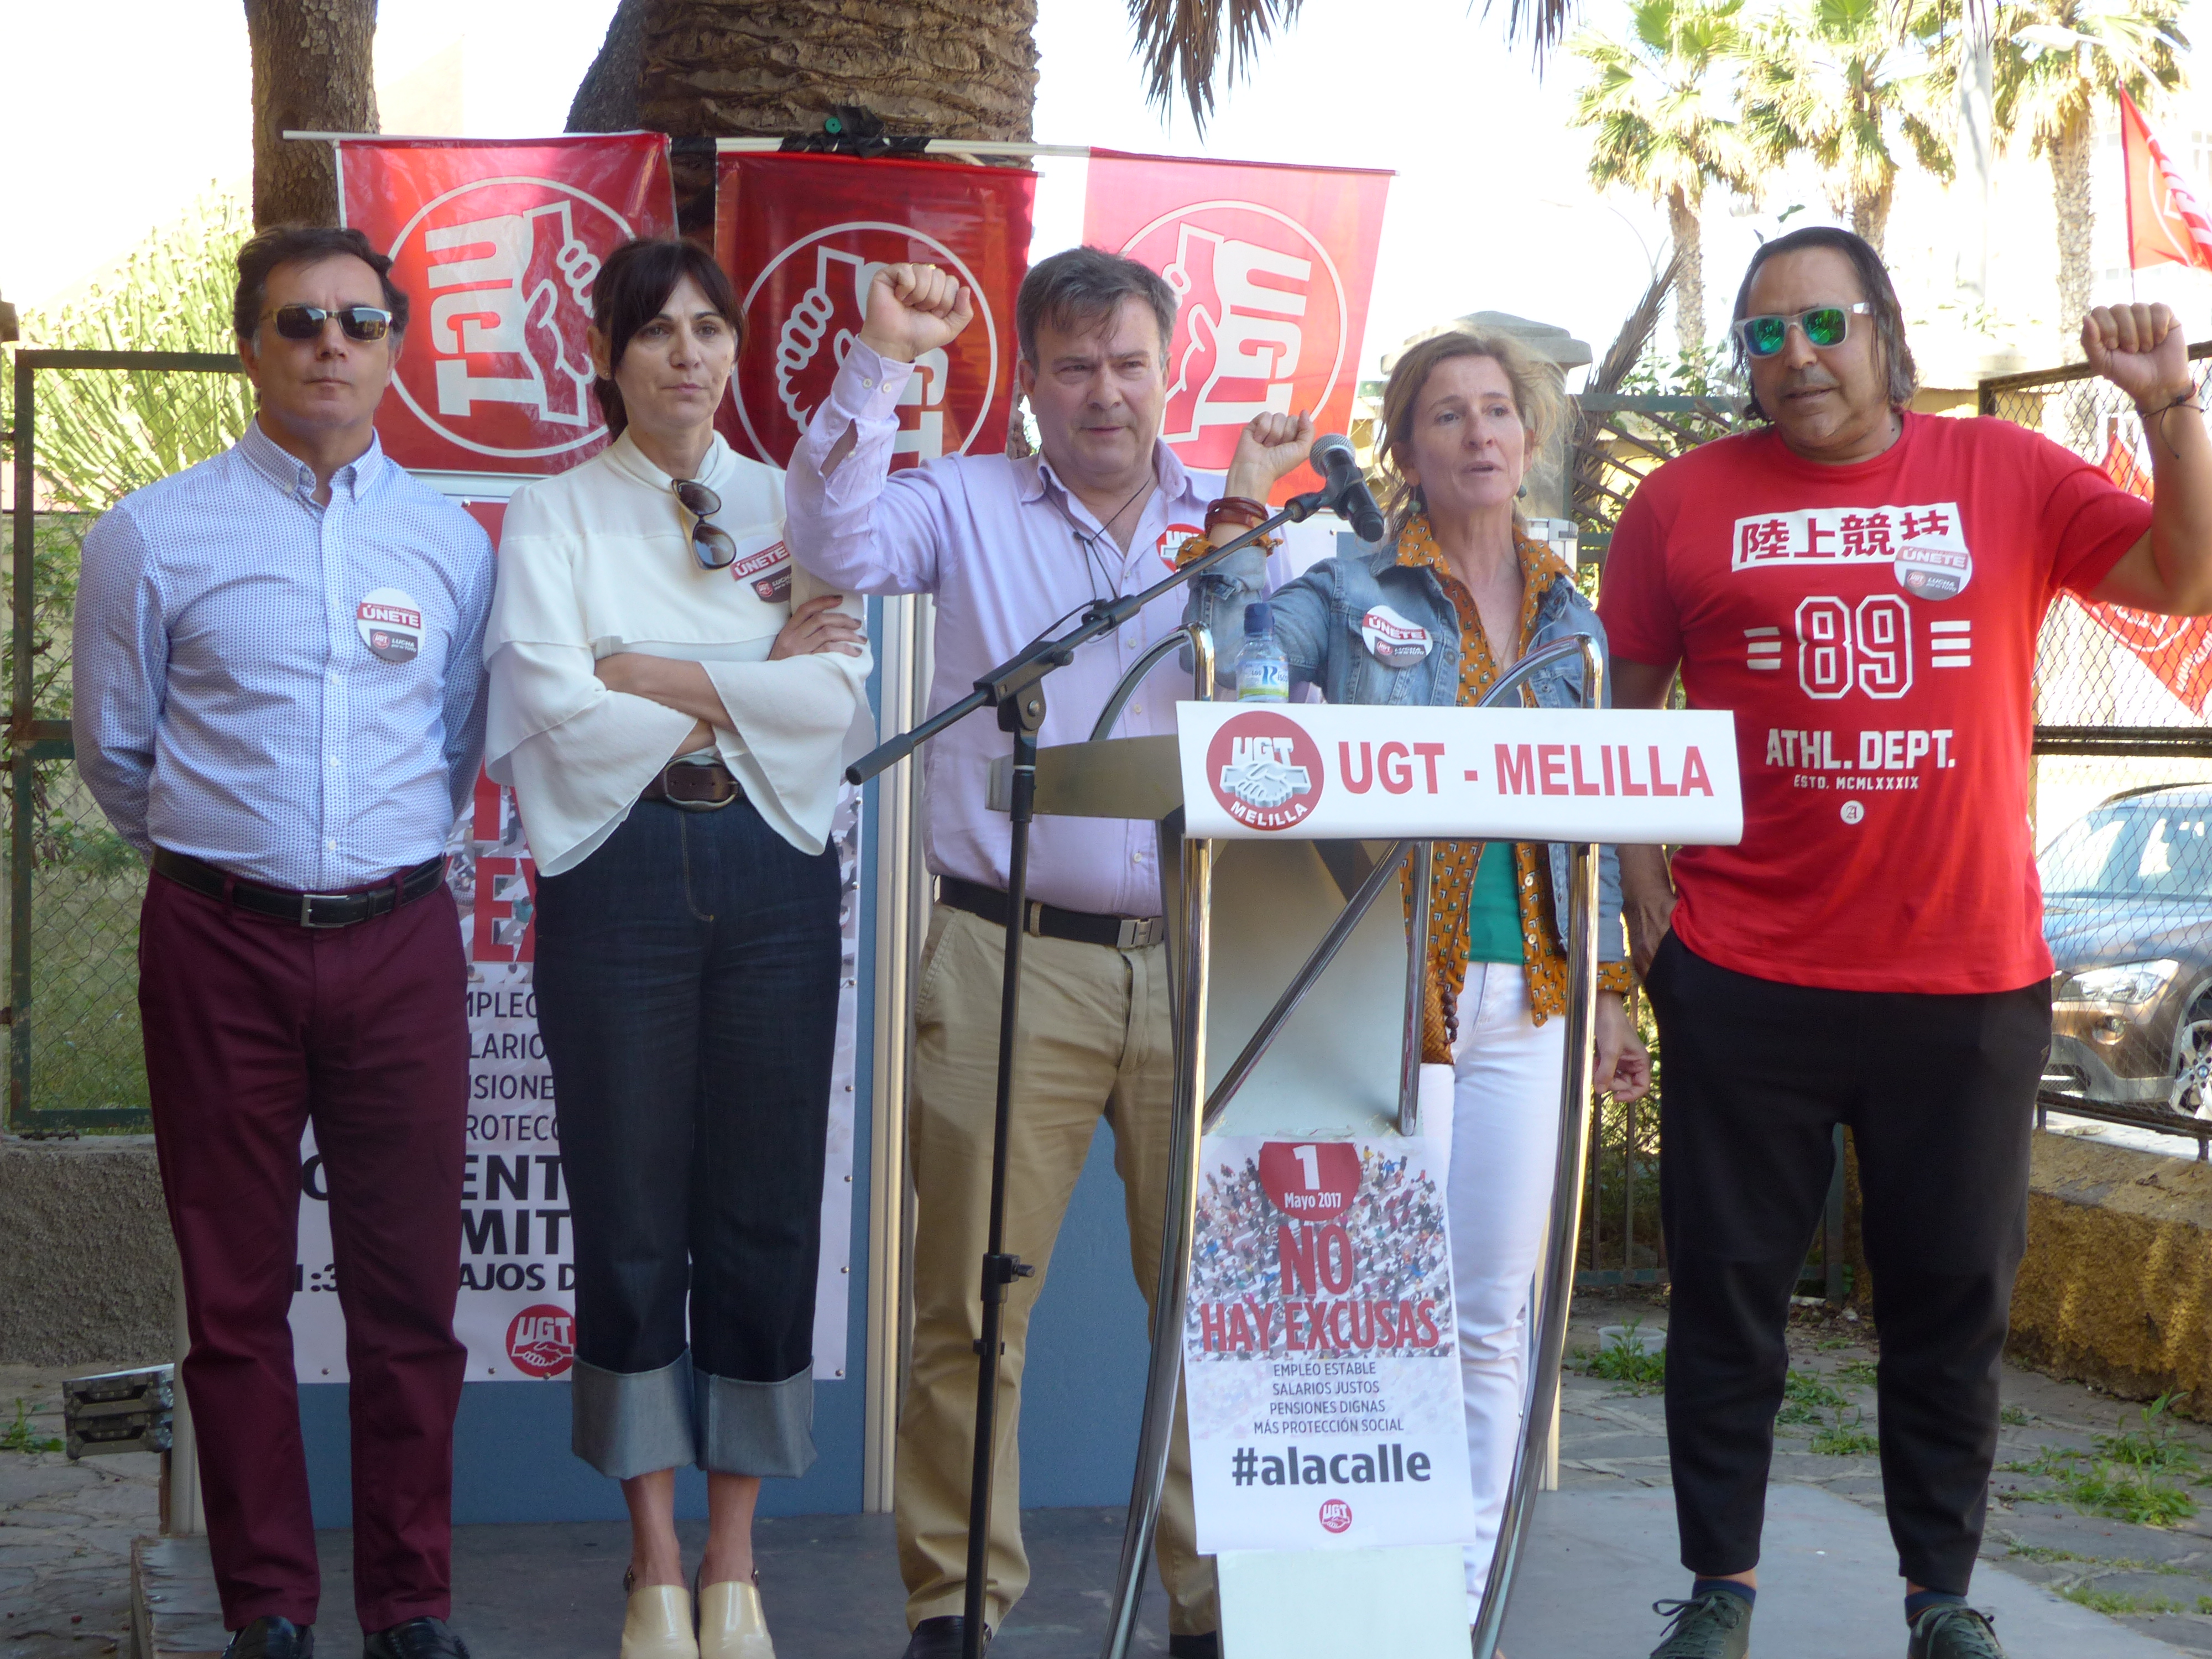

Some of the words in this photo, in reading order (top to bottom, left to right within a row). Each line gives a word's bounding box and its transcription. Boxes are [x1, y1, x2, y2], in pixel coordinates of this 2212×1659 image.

[735, 545, 789, 576] ÚNETE
[1902, 548, 1966, 568] ÚNETE
[363, 604, 419, 627] ÚNETE
[1369, 616, 1424, 640] ÚNETE
[392, 638, 415, 648] LUCHA
[1794, 594, 1913, 700] 89
[1231, 737, 1294, 768] UGT
[1338, 741, 1445, 795] UGT
[1494, 744, 1714, 797] MELILLA
[1835, 775, 1919, 790] MCMLXXXIX
[1230, 801, 1308, 827] MELILLA
[1293, 1145, 1321, 1191] 1
[1284, 1193, 1316, 1210] Mayo
[1318, 1192, 1341, 1208] 2017
[1278, 1224, 1354, 1296] NO
[514, 1316, 572, 1344] UGT
[1201, 1302, 1274, 1352] HAY
[1285, 1300, 1439, 1351] EXCUSAS
[1274, 1363, 1321, 1376] EMPLEO
[1324, 1361, 1376, 1375] ESTABLE
[1272, 1382, 1332, 1396] SALARIOS
[1335, 1380, 1380, 1394] JUSTOS
[1270, 1401, 1337, 1415] PENSIONES
[1340, 1400, 1385, 1413] DIGNAS
[1254, 1419, 1279, 1434] MÁS
[1282, 1418, 1358, 1433] PROTECCIÓN
[1361, 1418, 1404, 1432] SOCIAL
[1232, 1443, 1431, 1486] #alacalle
[1323, 1504, 1347, 1519] UGT
